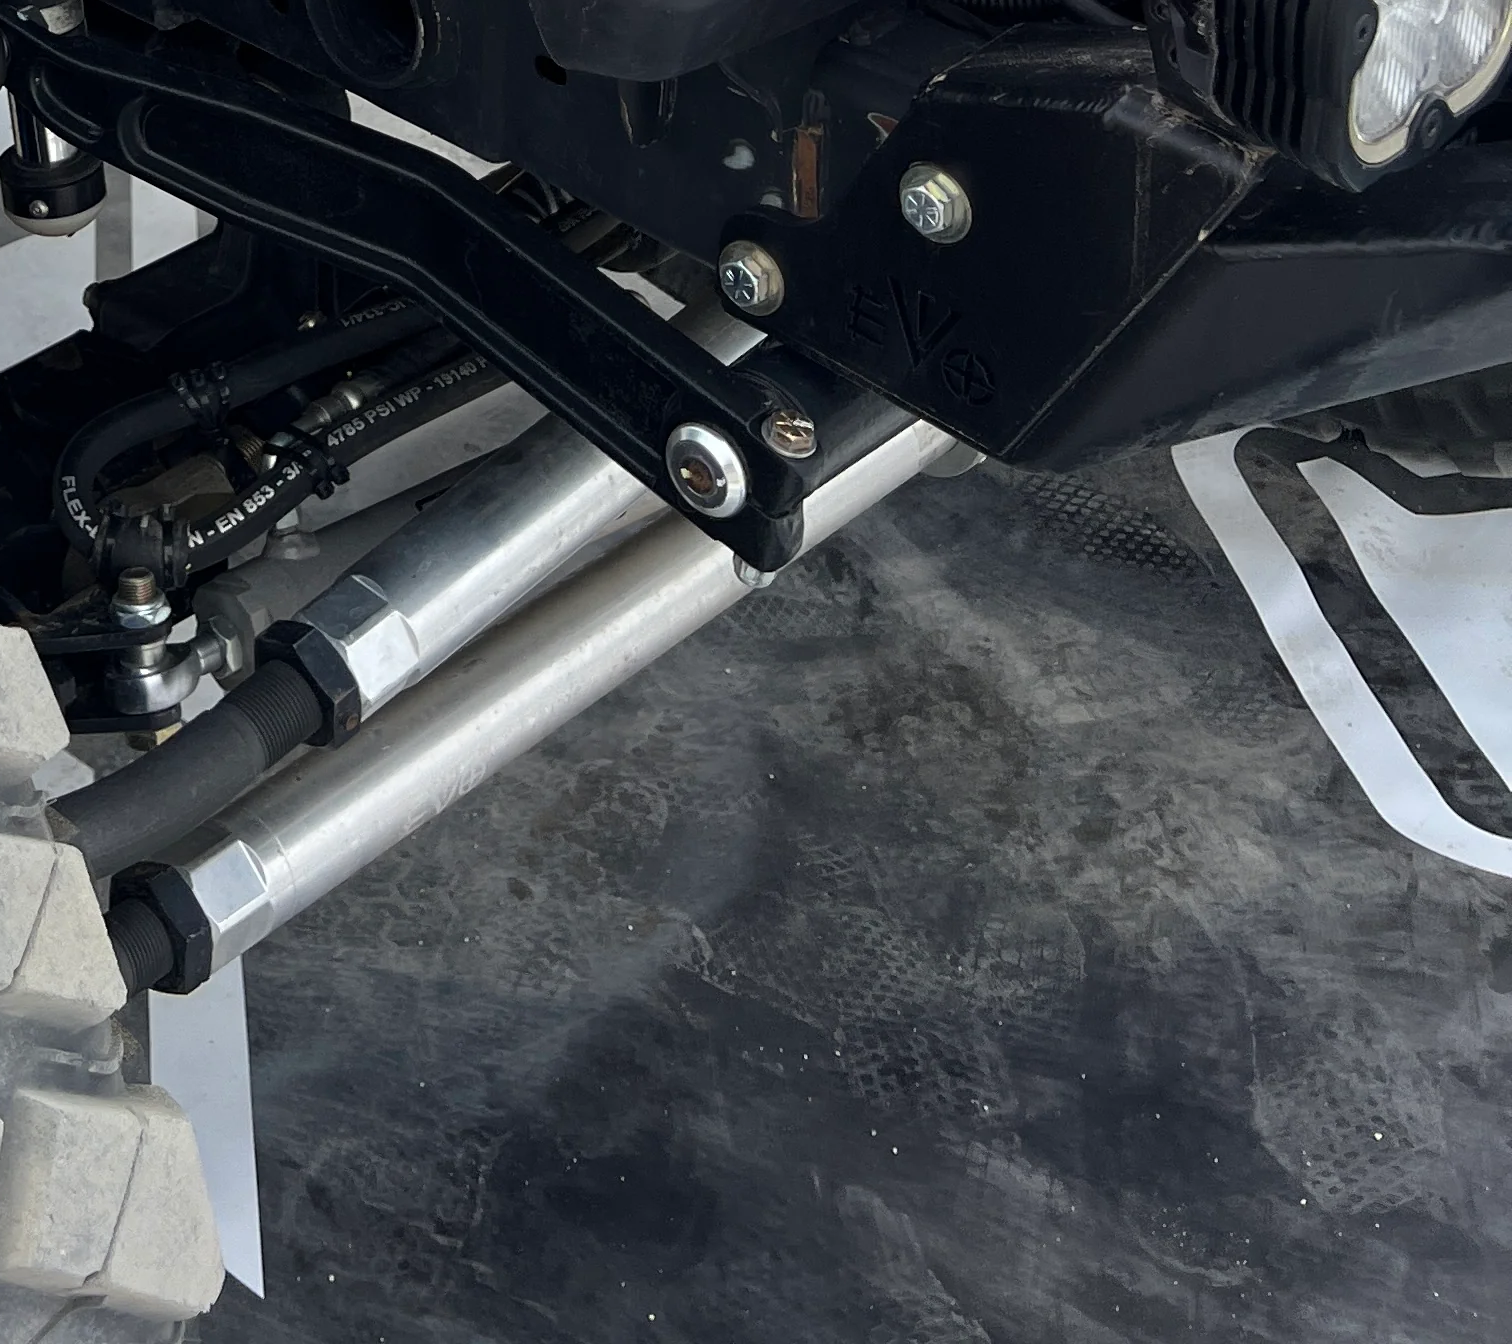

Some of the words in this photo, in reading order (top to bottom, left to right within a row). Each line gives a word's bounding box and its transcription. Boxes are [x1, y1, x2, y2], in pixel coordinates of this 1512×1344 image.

[214, 507, 245, 534] EN
[242, 484, 276, 513] 853
[326, 417, 366, 447] 4785
[363, 400, 397, 424] PSI
[392, 385, 422, 408] WP
